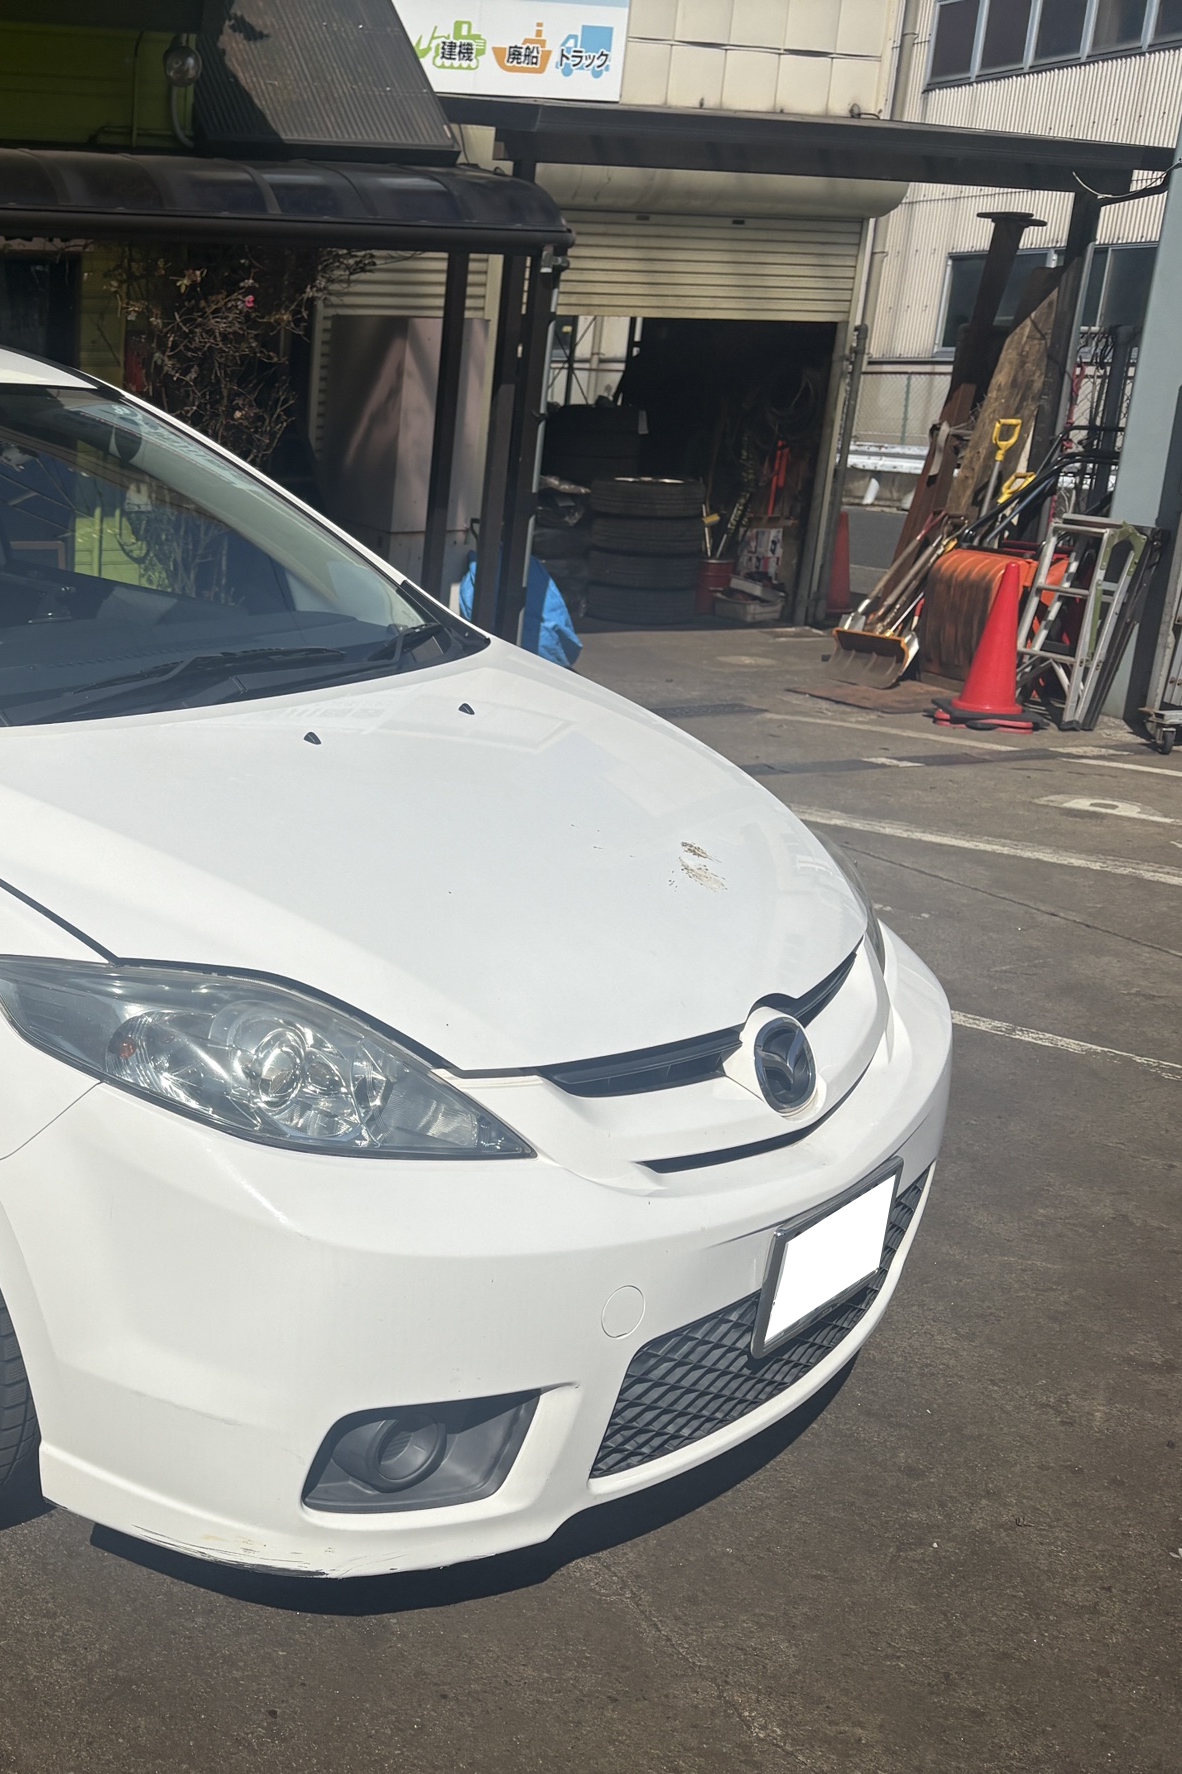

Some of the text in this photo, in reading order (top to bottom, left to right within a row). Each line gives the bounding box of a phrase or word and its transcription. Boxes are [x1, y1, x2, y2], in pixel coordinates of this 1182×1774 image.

[440, 41, 474, 62] 建機
[506, 45, 540, 66] 廃船
[559, 48, 609, 70] トラック
